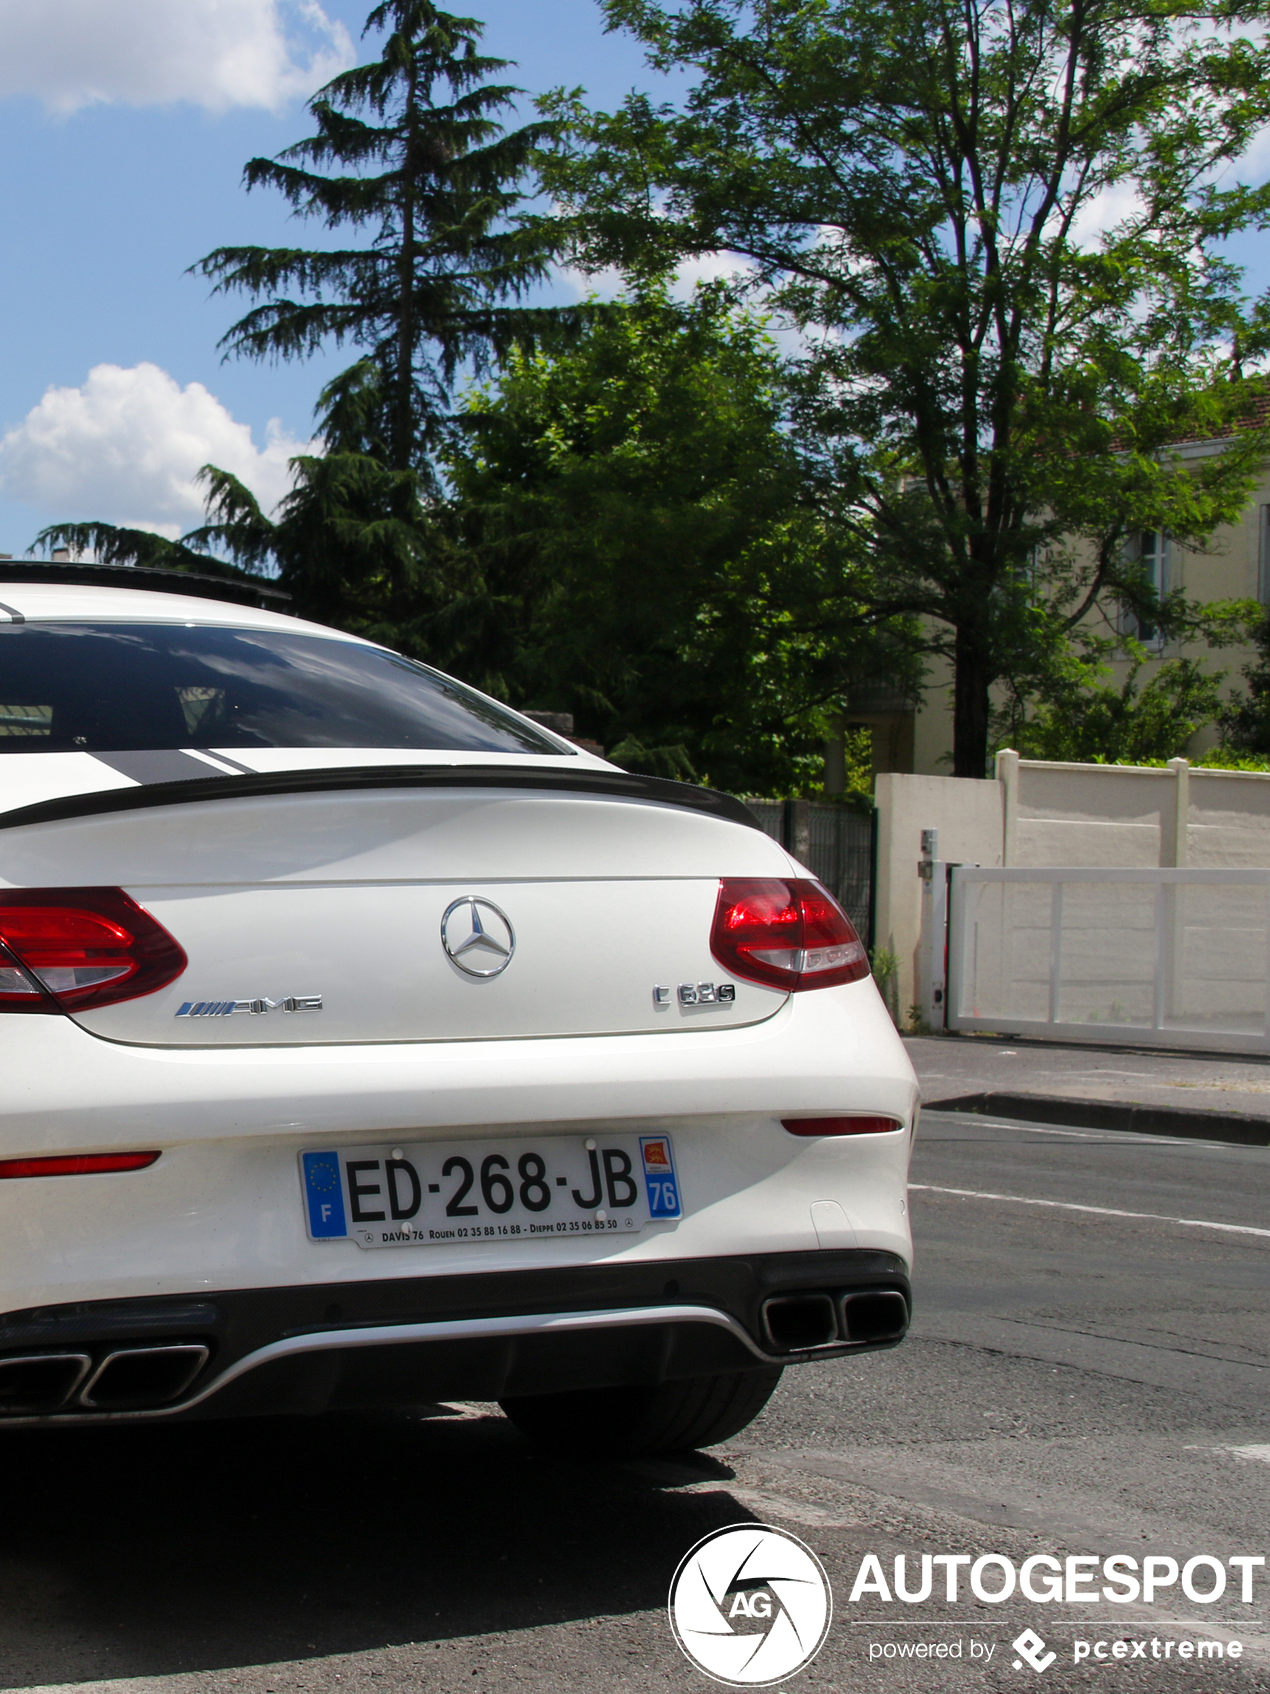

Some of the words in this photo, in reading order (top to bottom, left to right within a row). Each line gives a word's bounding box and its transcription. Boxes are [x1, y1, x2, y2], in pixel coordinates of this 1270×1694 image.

[230, 994, 323, 1015] AMG
[346, 1149, 637, 1223] ED-268-JB
[649, 1182, 676, 1211] 76
[320, 1204, 332, 1222] F
[382, 1231, 410, 1242] DAVIS
[413, 1230, 424, 1240] 76
[457, 1226, 468, 1237] 02
[471, 1226, 481, 1236] 35
[484, 1225, 495, 1236] 88
[498, 1225, 508, 1235] 16
[510, 1225, 521, 1234] 88
[556, 1221, 567, 1231] 02
[569, 1221, 579, 1231] 35
[582, 1220, 592, 1230] 06
[595, 1220, 605, 1230] 85
[607, 1219, 618, 1229] 50
